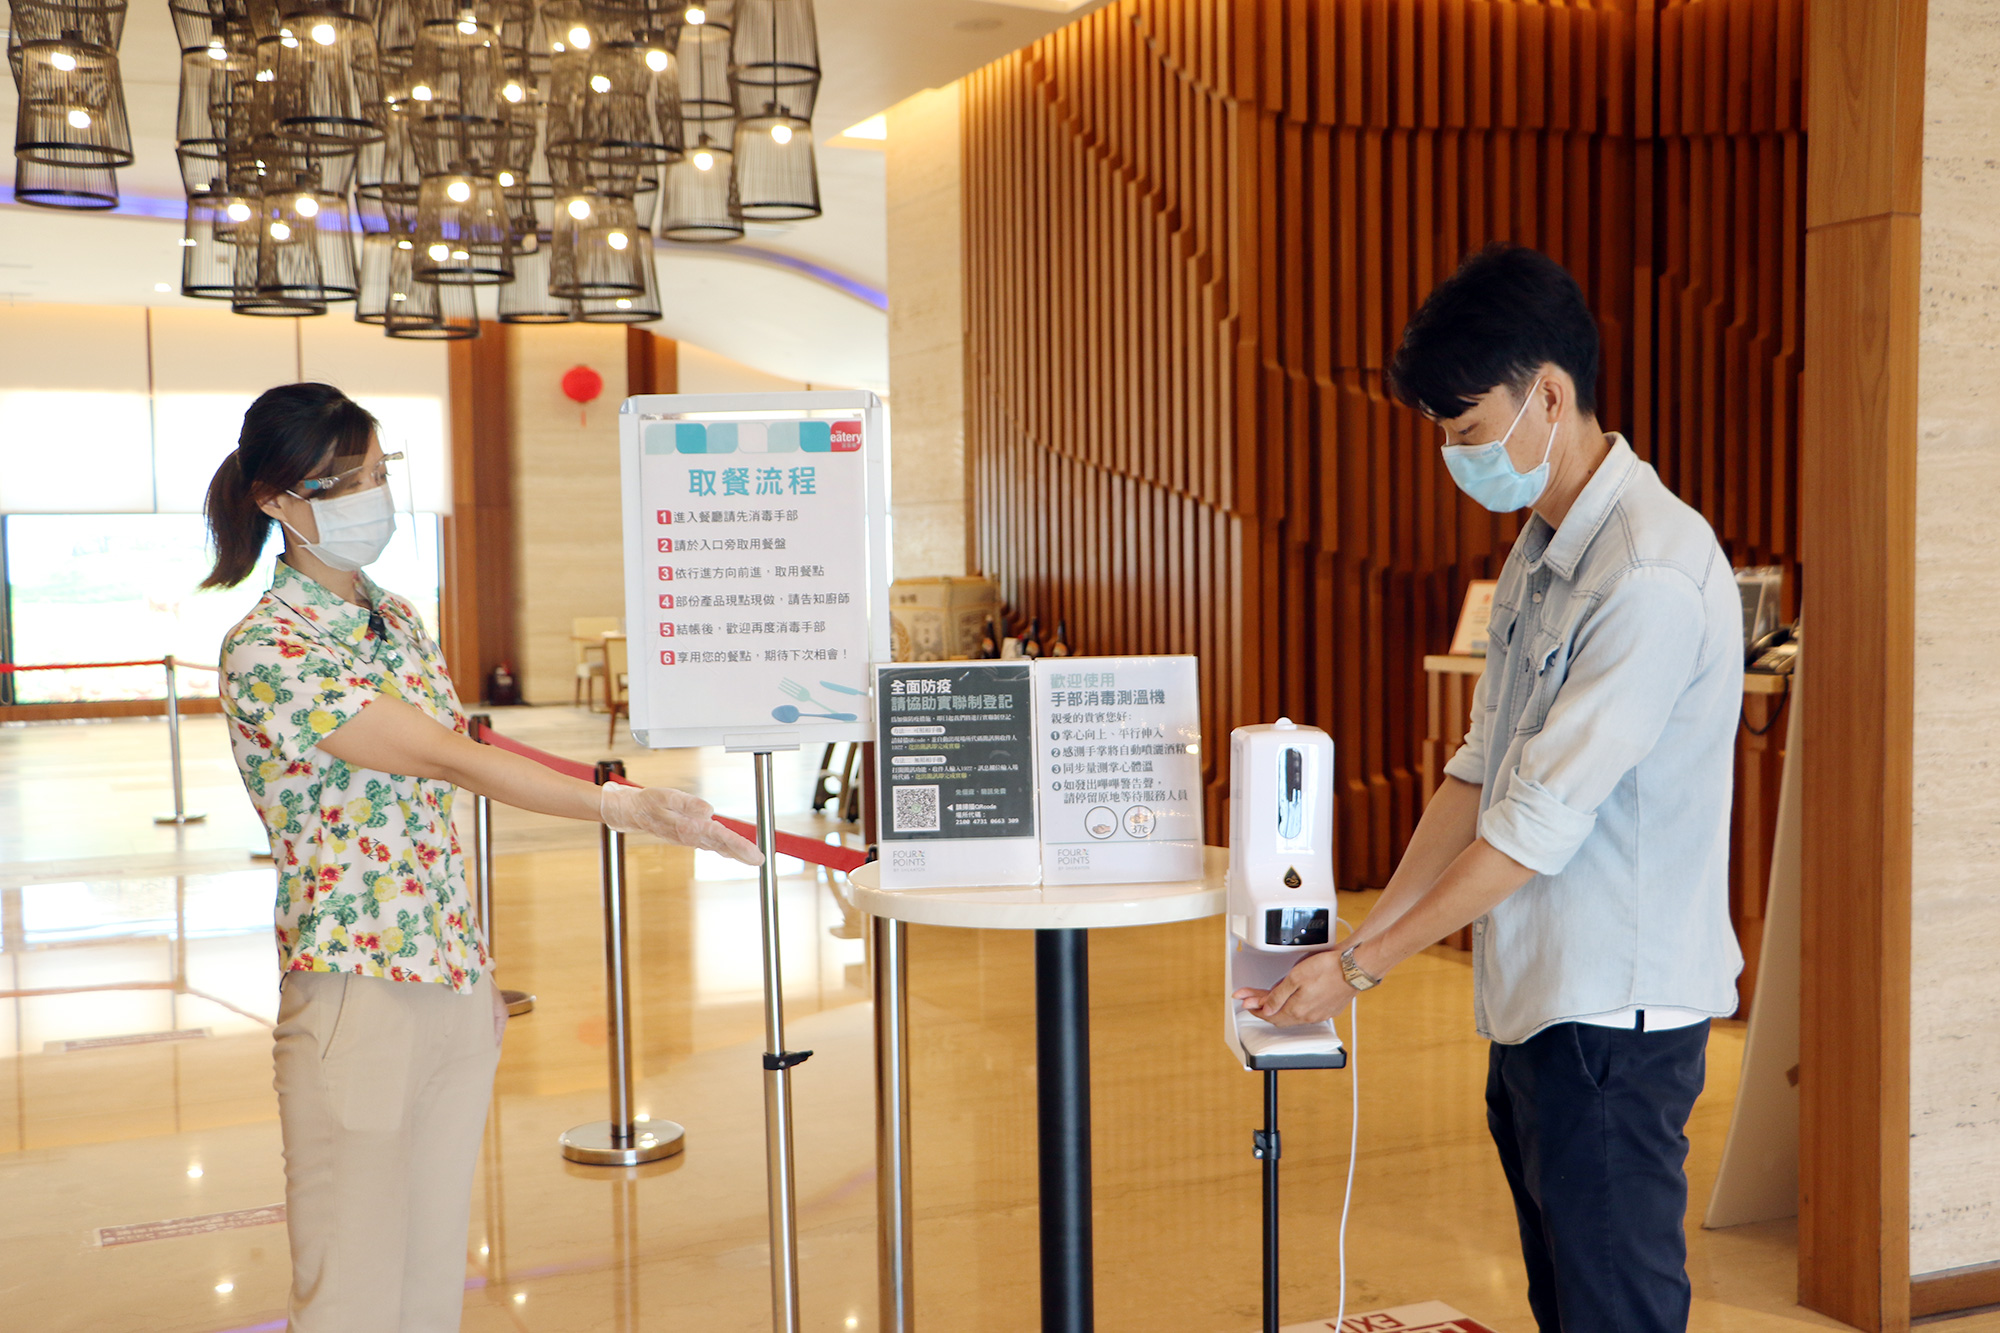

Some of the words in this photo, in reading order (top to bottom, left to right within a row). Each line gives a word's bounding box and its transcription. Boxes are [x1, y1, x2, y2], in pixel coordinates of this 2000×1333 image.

[688, 466, 816, 497] 取餐流程
[673, 509, 799, 524] 進入餐廳請先消毒手部
[674, 537, 787, 551] 請於入口旁取用餐盤
[675, 565, 825, 580] 依行進方向前進，取用餐點
[676, 621, 826, 636] 結帳後，歡迎再度消毒手部
[890, 678, 952, 695] 全面防疫
[1050, 672, 1115, 689] 歡迎使用
[891, 694, 1013, 712] 請協助實聯制登記
[1051, 689, 1166, 707] 手部消毒測溫機
[1062, 727, 1164, 741] 掌心向上、平行伸入
[1062, 743, 1186, 757] 感測手掌將自動噴灑酒精
[1063, 760, 1153, 774] 同步量測掌心體溫
[1063, 789, 1188, 804] 請停留原地等待服務人員
[893, 850, 918, 858] FOUR
[1057, 848, 1082, 856] FOUR
[893, 858, 926, 866] POINTS
[1057, 856, 1090, 865] POINTS
